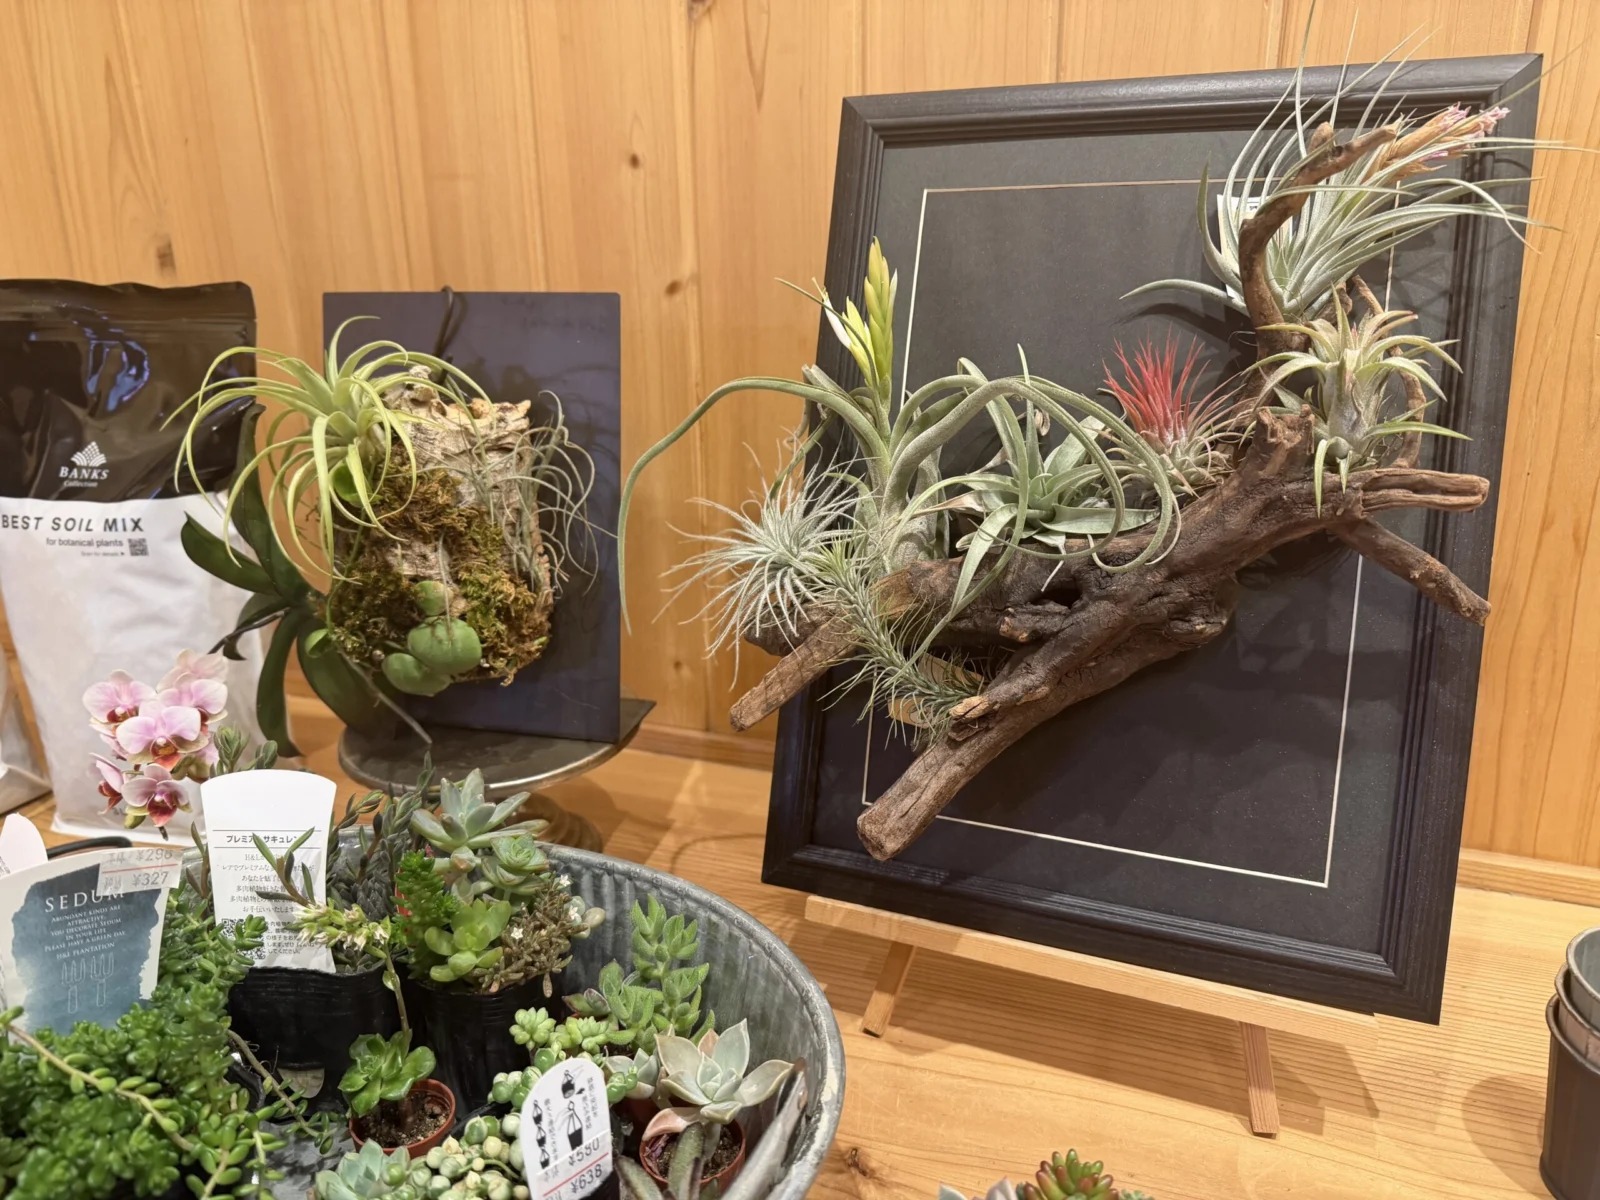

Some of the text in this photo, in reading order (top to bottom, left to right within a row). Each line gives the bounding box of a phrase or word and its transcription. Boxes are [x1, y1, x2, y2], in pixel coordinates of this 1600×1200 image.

[59, 466, 110, 480] BANKS
[1, 514, 144, 532] BEST SOIL MIX
[58, 538, 94, 546] botanical
[96, 539, 124, 548] plants
[226, 835, 297, 843] プレミアサキュレ
[132, 871, 169, 887] ¥327
[51, 911, 87, 923] ABUNDANT
[88, 907, 108, 915] KINDS
[66, 922, 98, 934] DECORATE
[75, 931, 93, 939] YOUR
[67, 939, 83, 947] HAVE
[91, 933, 112, 942] GREEN
[72, 942, 115, 956] PLANTATION
[568, 1137, 600, 1166] ¥580
[570, 1163, 602, 1193] ¥638
